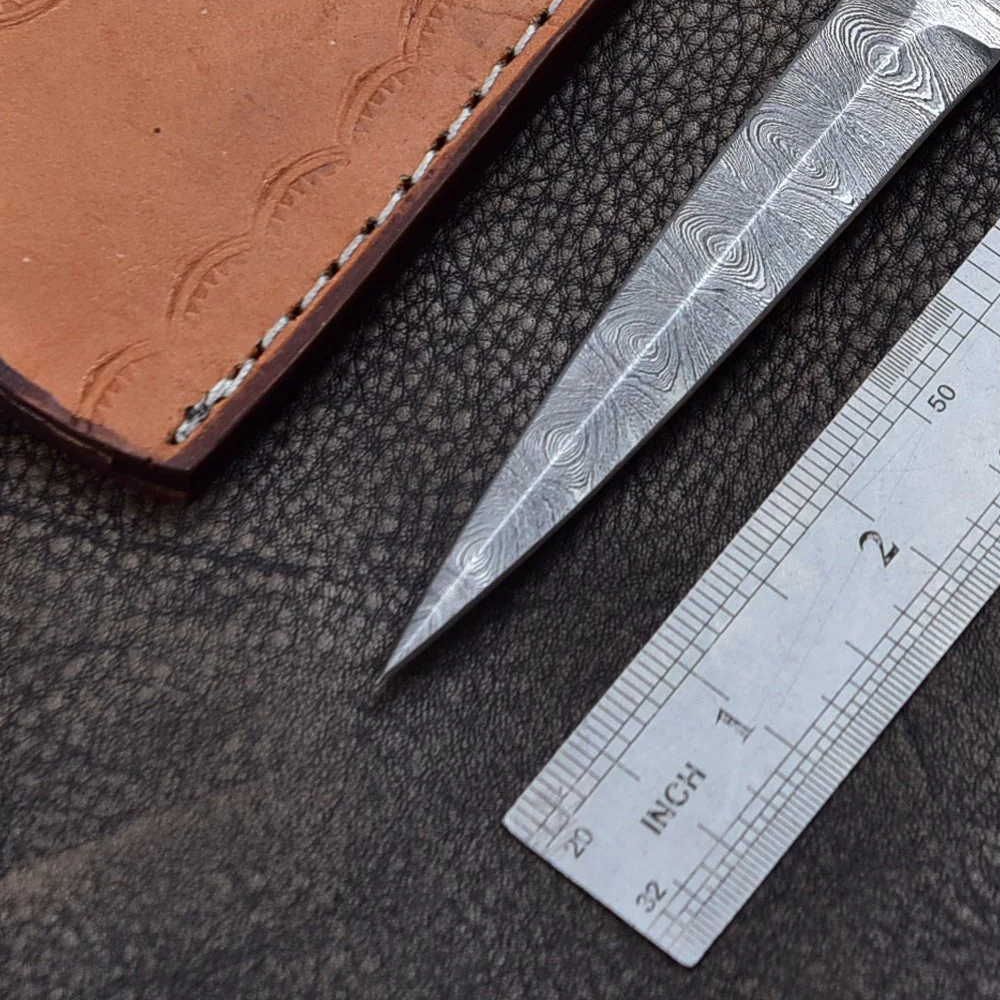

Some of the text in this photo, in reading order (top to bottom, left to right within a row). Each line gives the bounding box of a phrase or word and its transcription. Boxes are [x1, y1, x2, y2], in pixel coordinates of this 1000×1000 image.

[927, 384, 956, 413] 50
[859, 530, 900, 567] 2
[715, 708, 756, 743] 1
[640, 762, 707, 835] INCH
[562, 827, 594, 859] 20
[635, 879, 668, 913] 32
